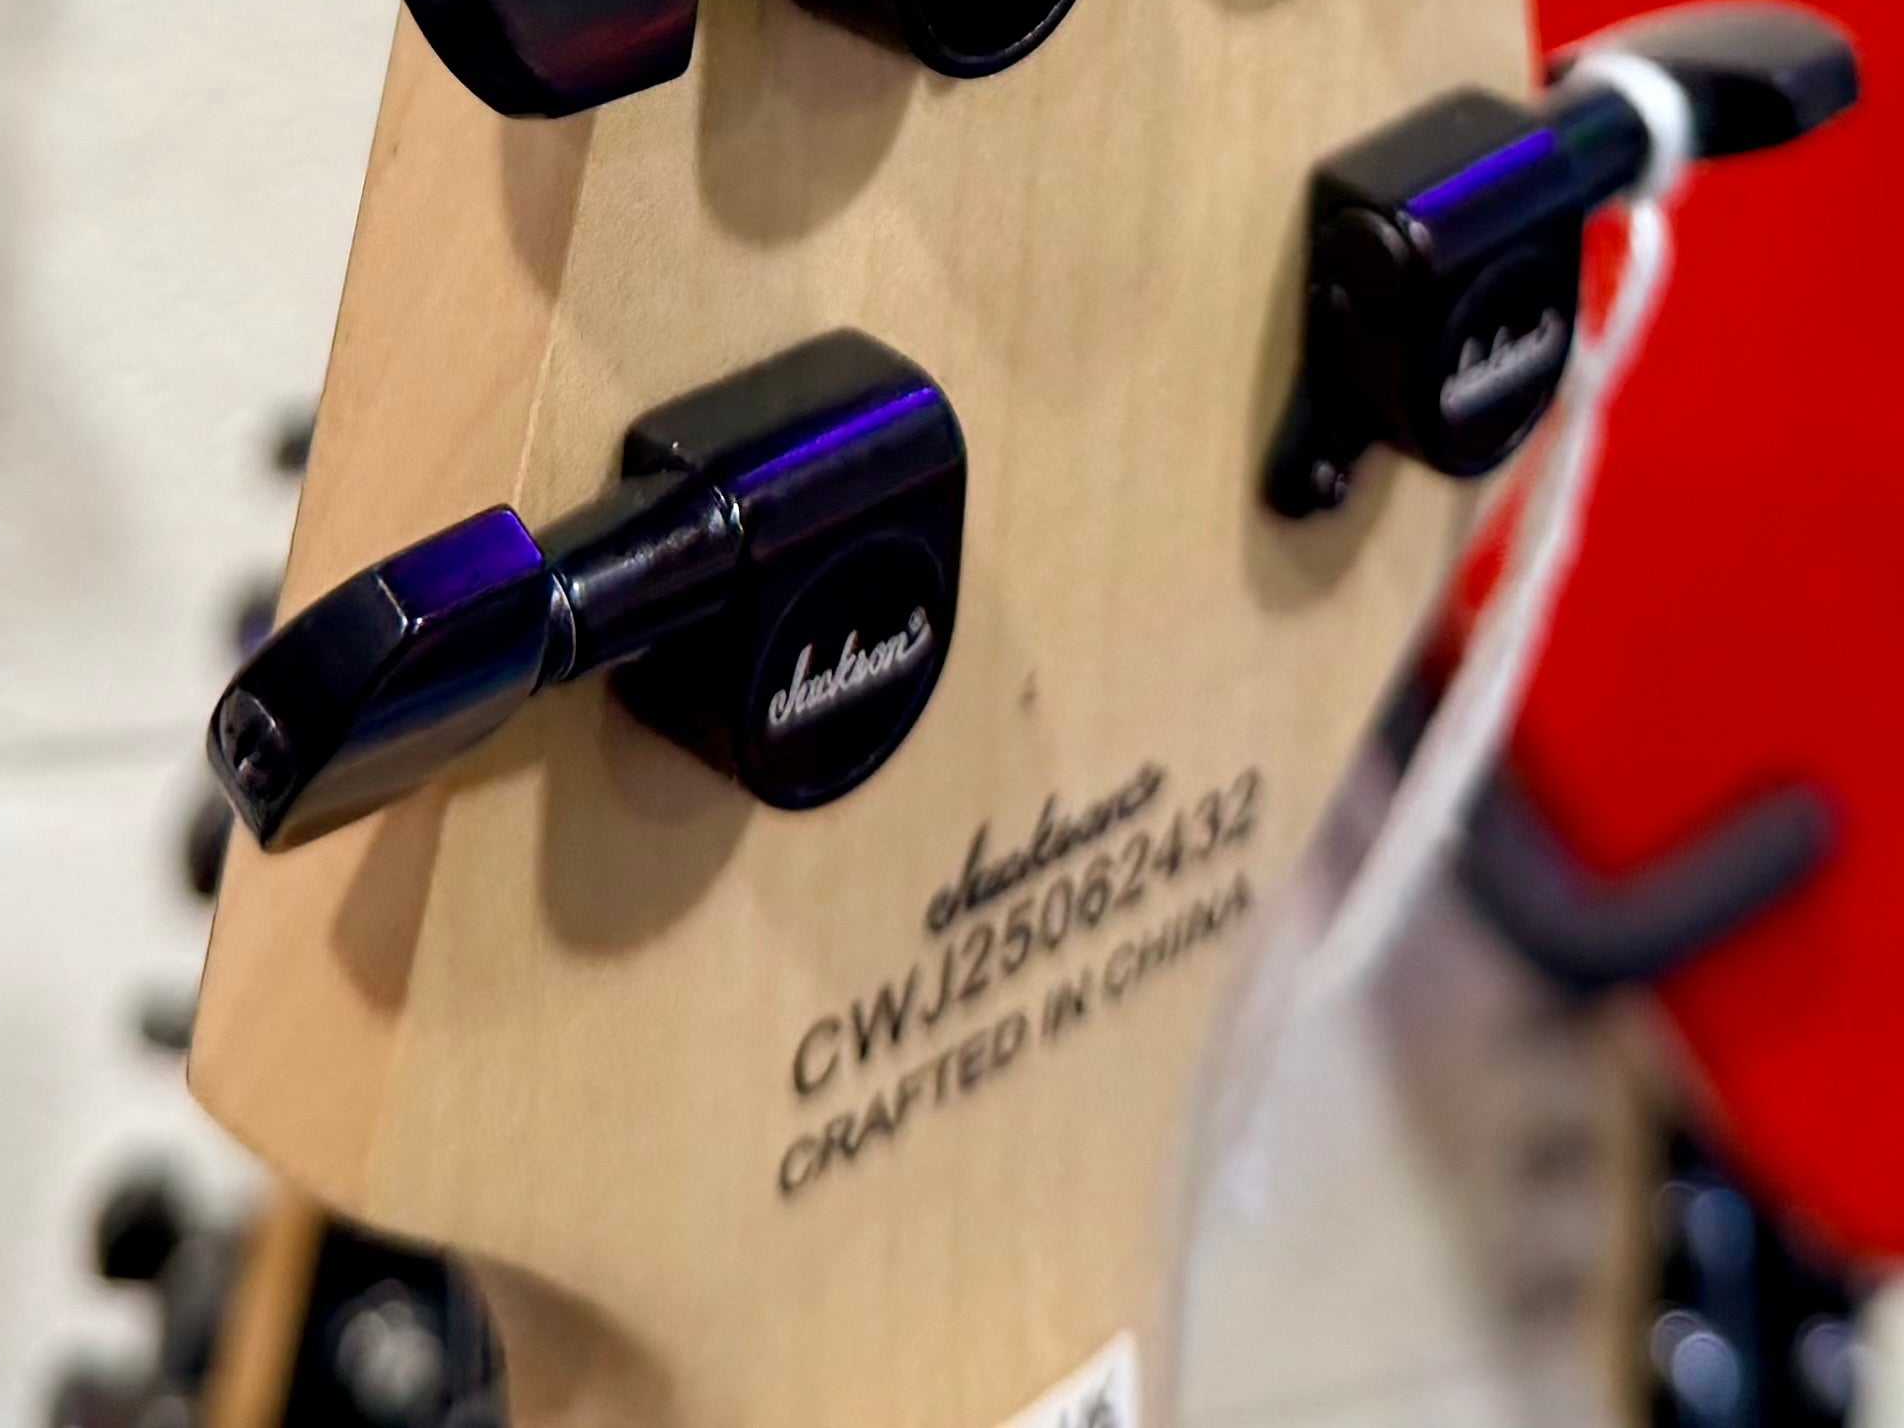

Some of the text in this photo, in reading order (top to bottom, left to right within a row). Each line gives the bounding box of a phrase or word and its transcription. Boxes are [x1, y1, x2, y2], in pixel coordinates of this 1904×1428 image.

[777, 868, 1252, 1199] CRAFTED IN CHINA
[792, 762, 1262, 1097] CWJ25062432
